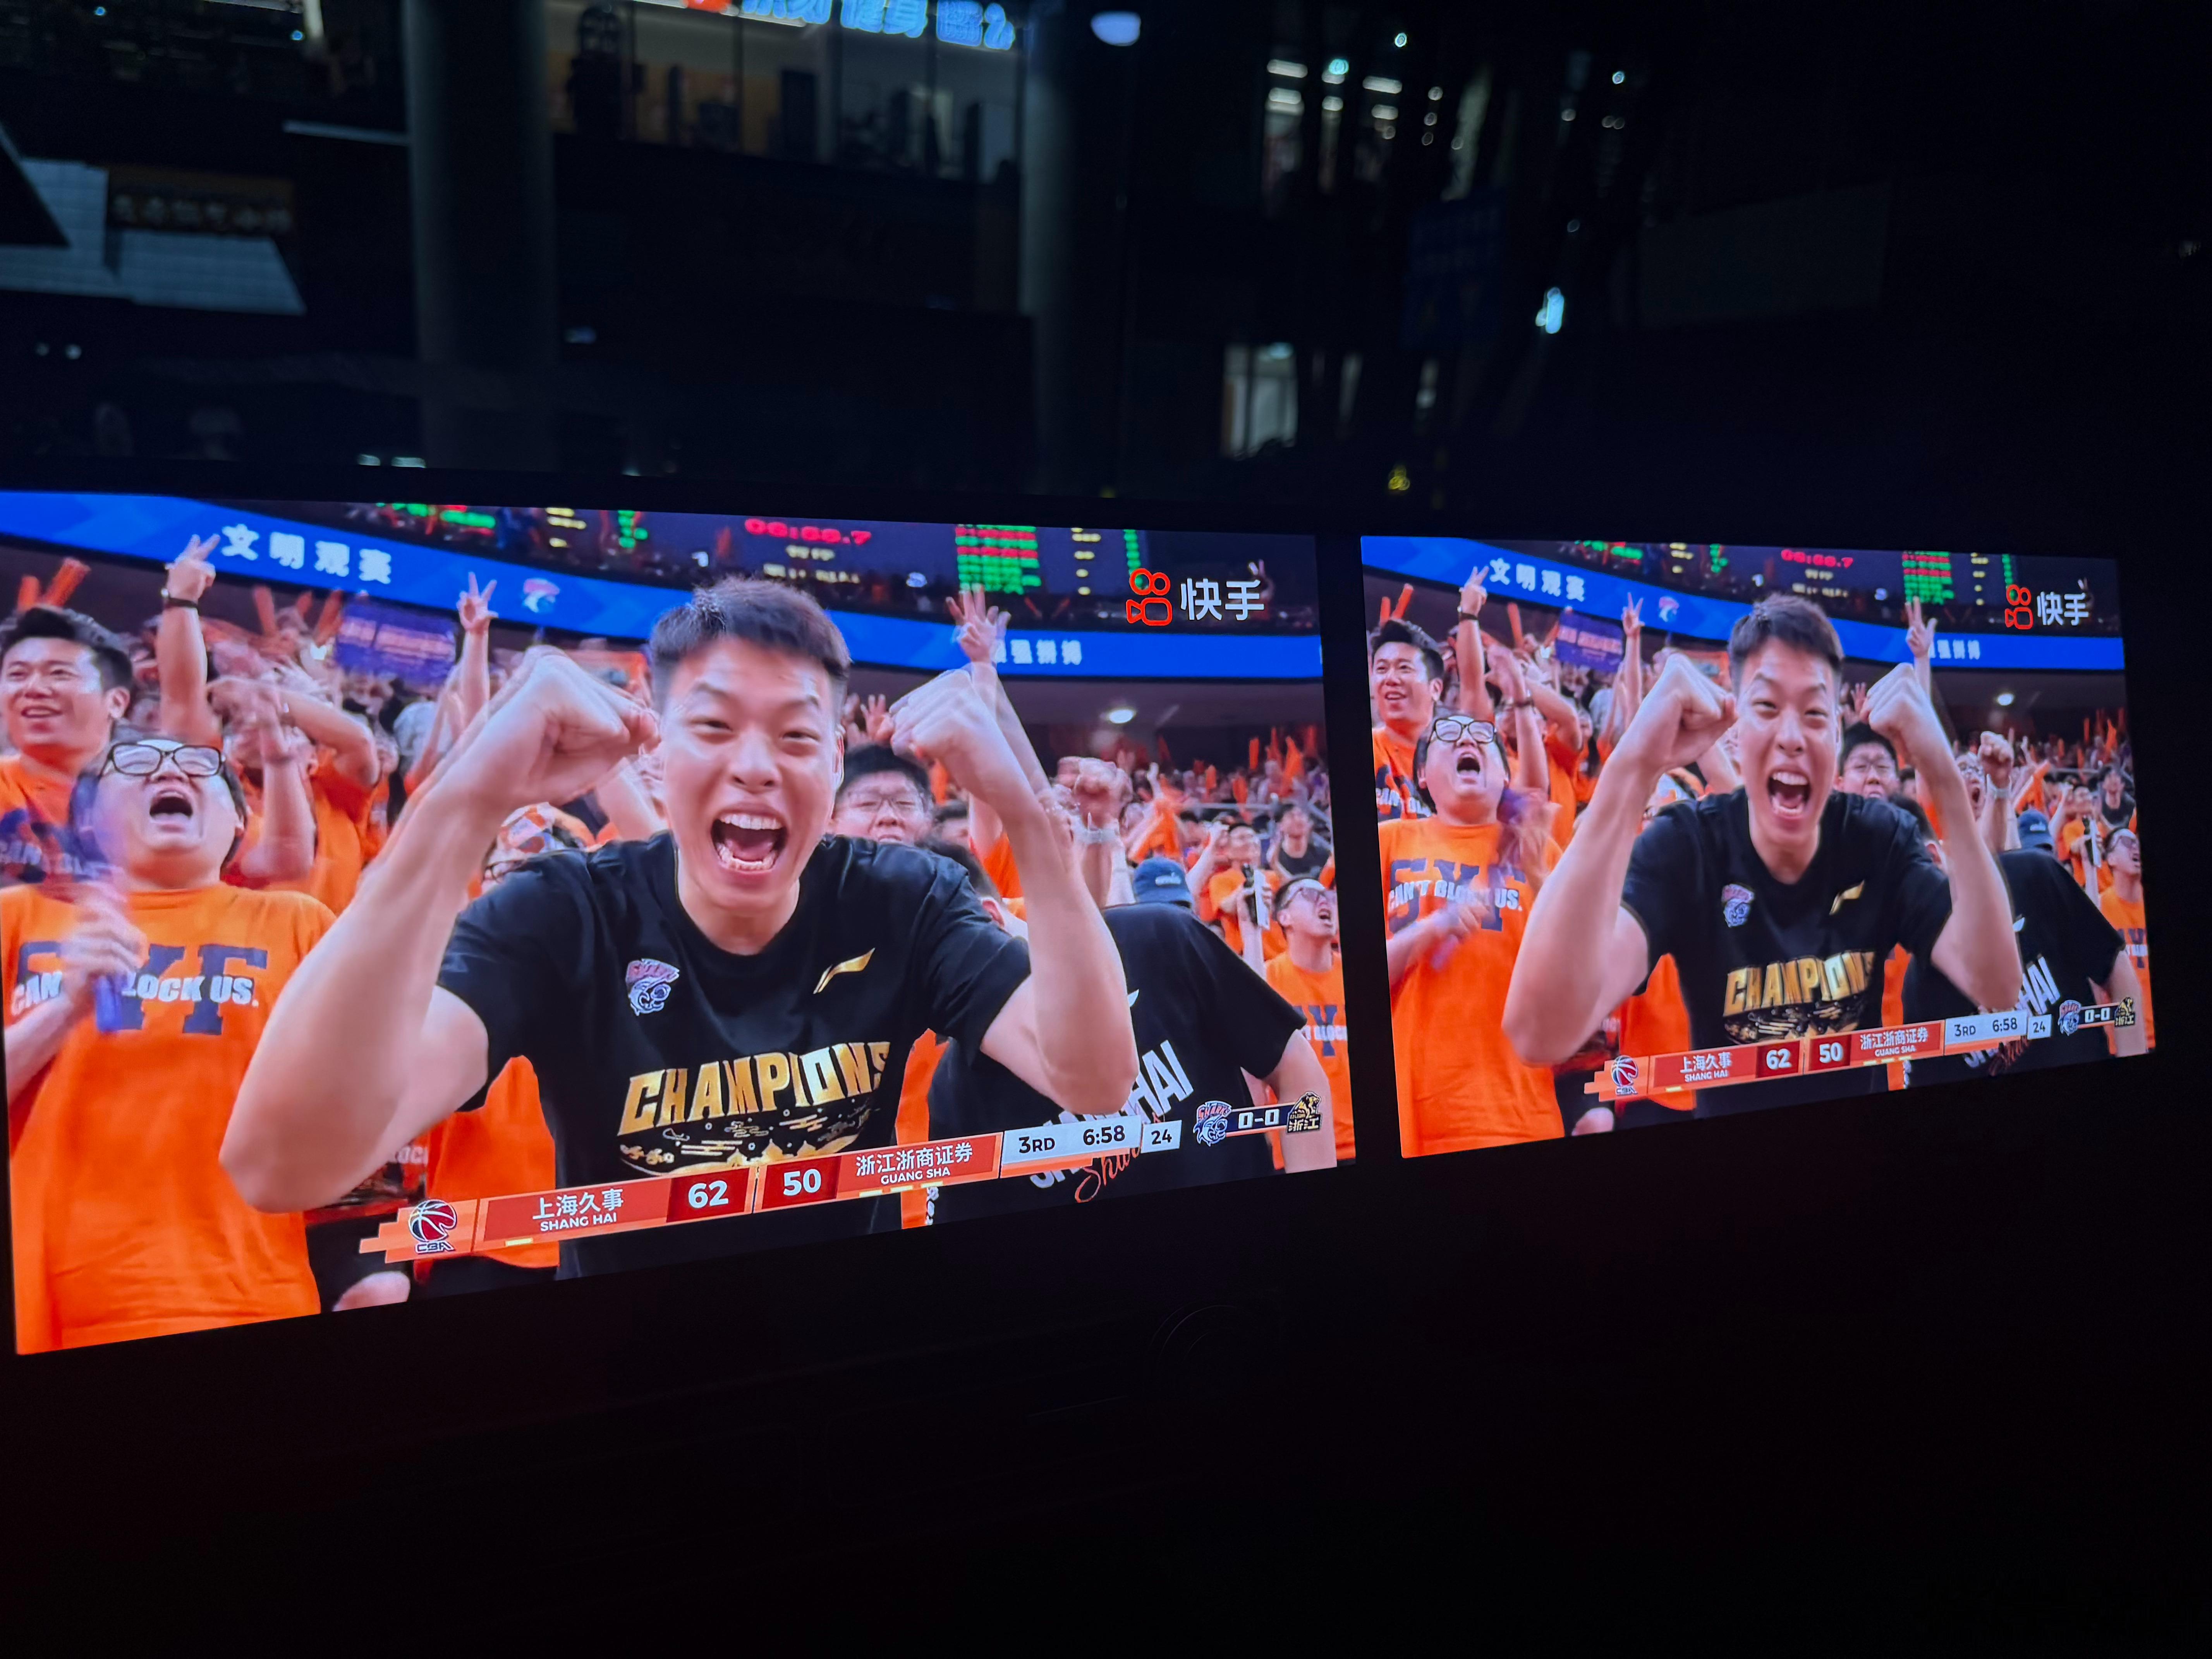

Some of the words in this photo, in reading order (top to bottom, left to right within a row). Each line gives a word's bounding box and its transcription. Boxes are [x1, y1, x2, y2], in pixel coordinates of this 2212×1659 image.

[1180, 578, 1264, 621] 快手
[2037, 591, 2089, 626] 快手
[2084, 1007, 2111, 1023] 0-0
[1954, 1023, 1976, 1037] 3RD
[1992, 1017, 2018, 1033] 6:58
[2033, 1022, 2046, 1034] 24
[1860, 1026, 1929, 1051] 浙江浙商证券
[1680, 1051, 1733, 1075] 上海久事
[1766, 1048, 1792, 1070] 62
[1819, 1043, 1843, 1063] 50
[1685, 1071, 1712, 1082] SHANG
[1713, 1070, 1729, 1079] HAI
[1238, 1109, 1279, 1129] 0-0
[1288, 1117, 1319, 1132] 浙江
[1018, 1136, 1055, 1153] 3RD
[1083, 1125, 1125, 1146] 6:58
[1151, 1128, 1172, 1145] 24
[855, 1141, 973, 1178] 浙江浙商证券
[782, 1168, 822, 1197] 50
[879, 1170, 923, 1185] GUANG
[926, 1167, 951, 1180] SHA
[532, 1187, 624, 1220] 上海久事
[688, 1180, 729, 1209] 62
[539, 1214, 590, 1233] SHANG
[593, 1212, 617, 1226] HAI
